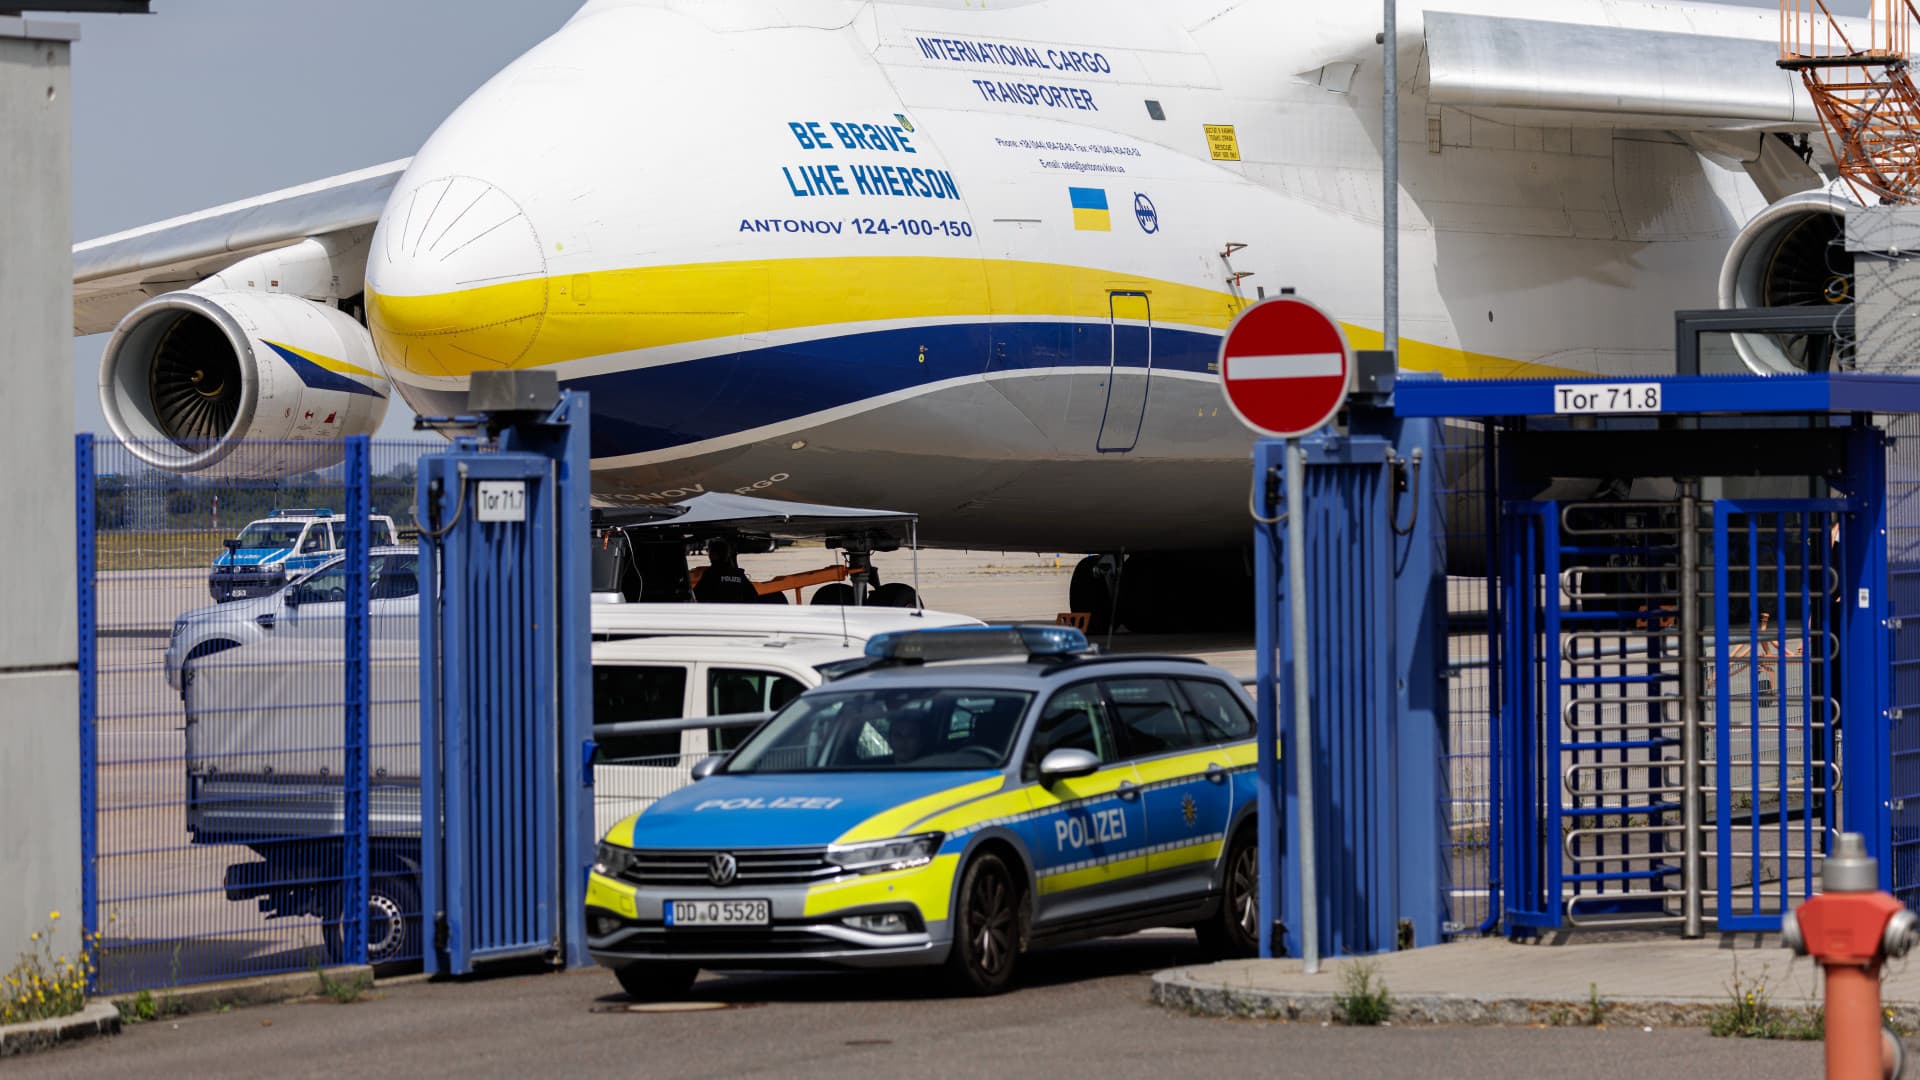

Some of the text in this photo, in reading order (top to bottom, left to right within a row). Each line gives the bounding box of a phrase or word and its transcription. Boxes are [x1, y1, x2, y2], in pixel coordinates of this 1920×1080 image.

[916, 37, 1111, 74] INTERNATIONAL CARGO
[972, 79, 1099, 111] TRANSPORTER
[788, 122, 834, 150] BE
[782, 165, 961, 200] LIKE KHERSON
[739, 217, 973, 237] ANTONOV 124-100-150
[1558, 387, 1657, 409] Tor 71.8
[735, 472, 790, 497] RGO
[482, 490, 524, 510] Tor 71.7
[694, 797, 844, 812] POLIZEI
[1055, 807, 1127, 852] POLIZEI
[676, 903, 697, 921] DD
[709, 903, 719, 921] Q
[723, 903, 766, 921] 5528
